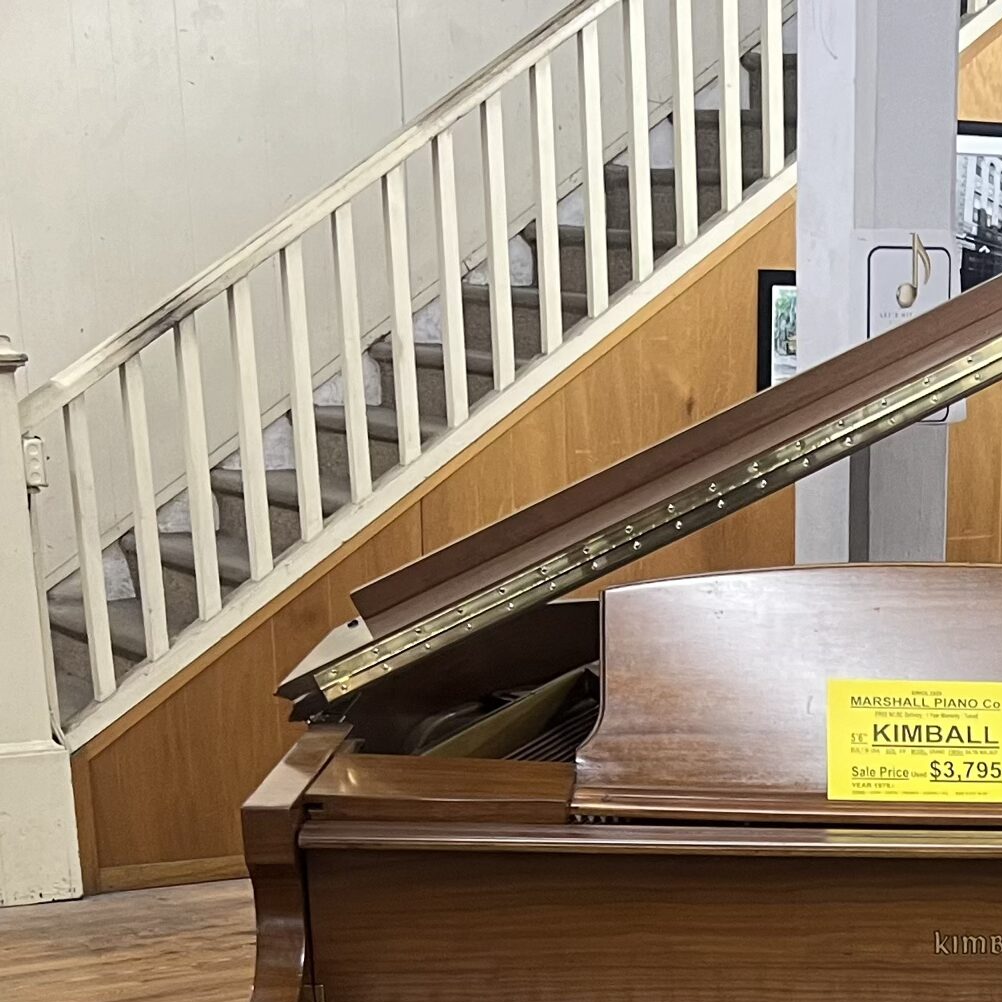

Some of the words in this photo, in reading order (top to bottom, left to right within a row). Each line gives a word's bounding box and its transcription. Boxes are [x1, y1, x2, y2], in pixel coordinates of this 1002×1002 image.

[850, 696, 930, 708] MARSHALL
[934, 698, 978, 709] PIANO
[982, 699, 1001, 709] Co
[873, 723, 999, 744] KIMBALL
[851, 765, 876, 778] Sale
[879, 766, 910, 779] Price
[929, 760, 1002, 781] $3,795
